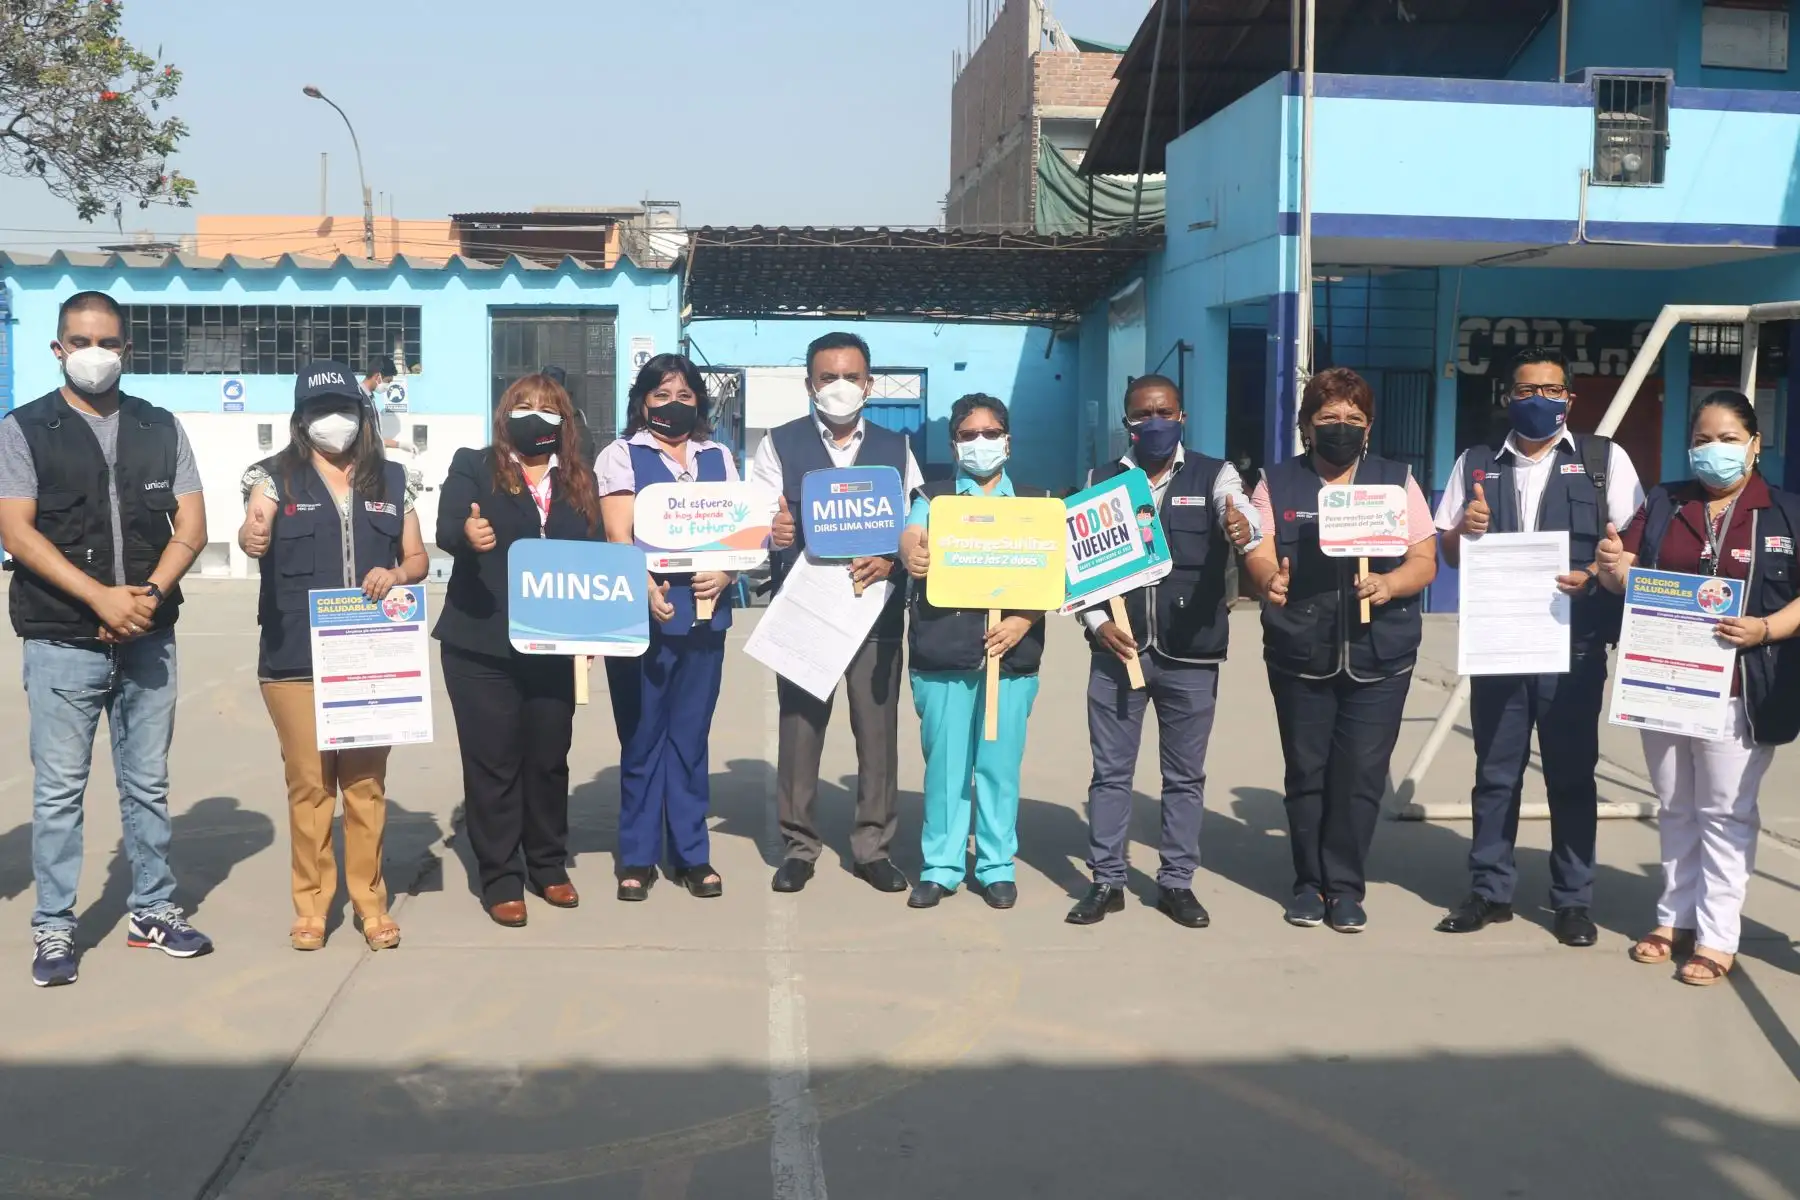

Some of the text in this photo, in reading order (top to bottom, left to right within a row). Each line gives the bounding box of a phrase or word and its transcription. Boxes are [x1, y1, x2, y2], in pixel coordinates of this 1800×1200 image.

[308, 372, 346, 388] MINSA
[668, 497, 733, 510] Del esfuerzo
[812, 496, 893, 520] MINSA
[663, 510, 724, 520] de hoy depende
[1066, 497, 1124, 541] TODOS
[669, 520, 736, 535] su futuro
[814, 519, 895, 533] DIRIS LIMA NORTE
[1072, 523, 1130, 560] VUELVEN
[952, 553, 1038, 566] Ponte las 2 dosis
[522, 571, 634, 602] MINSA
[1635, 577, 1680, 588] COLEGIOS
[1634, 585, 1693, 597] SALUDABLES
[317, 597, 363, 605] COLEGIOS
[317, 604, 378, 613] SALUDABLES
